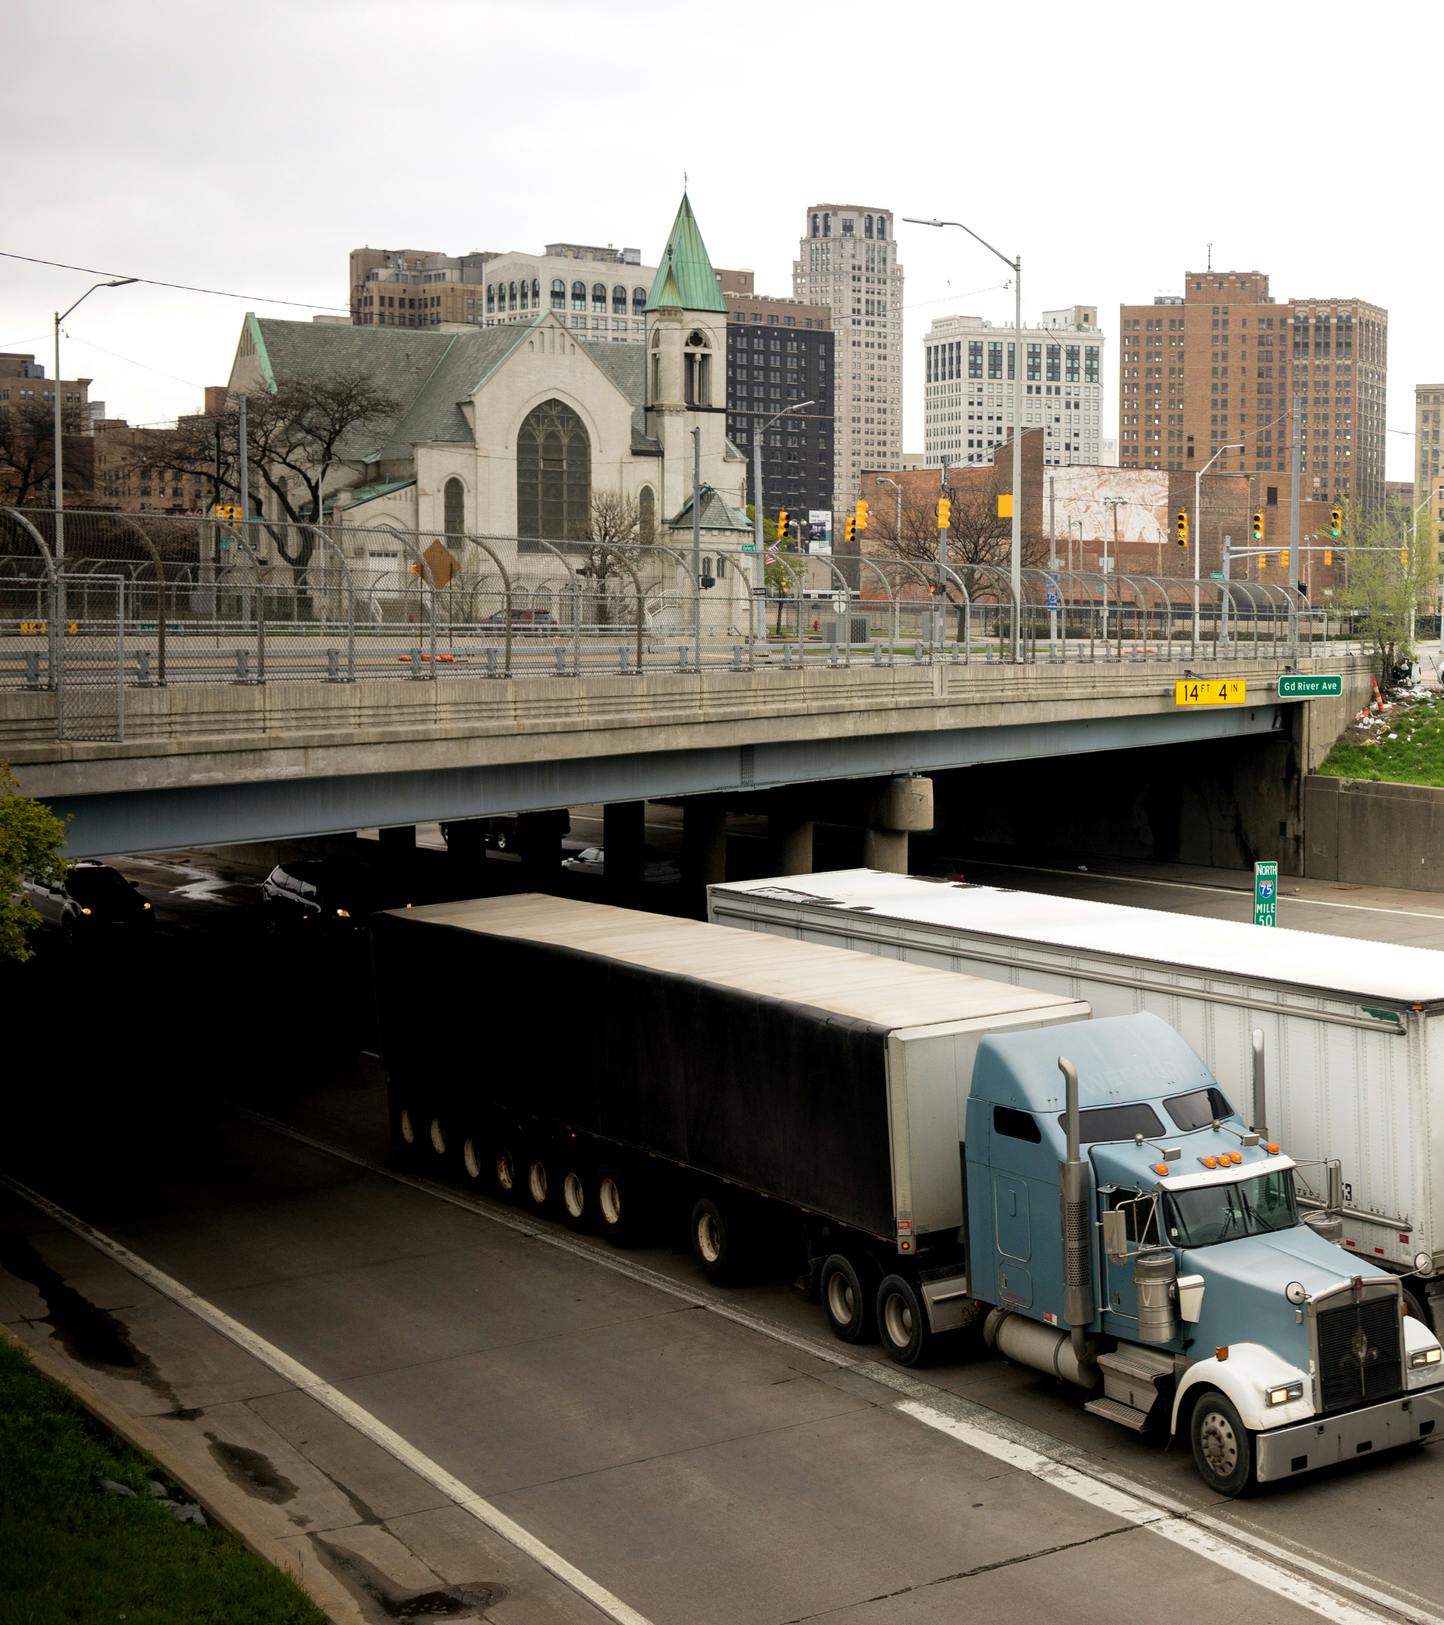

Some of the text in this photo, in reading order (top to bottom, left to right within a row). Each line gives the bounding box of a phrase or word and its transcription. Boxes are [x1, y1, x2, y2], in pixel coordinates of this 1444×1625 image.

[1284, 681, 1337, 691] Gd River Ave
[1184, 684, 1238, 701] 14 FT 4 IN
[1256, 865, 1277, 876] NORTH
[1260, 884, 1272, 895] 75
[1256, 903, 1275, 913] MILE
[1259, 914, 1273, 927] 50
